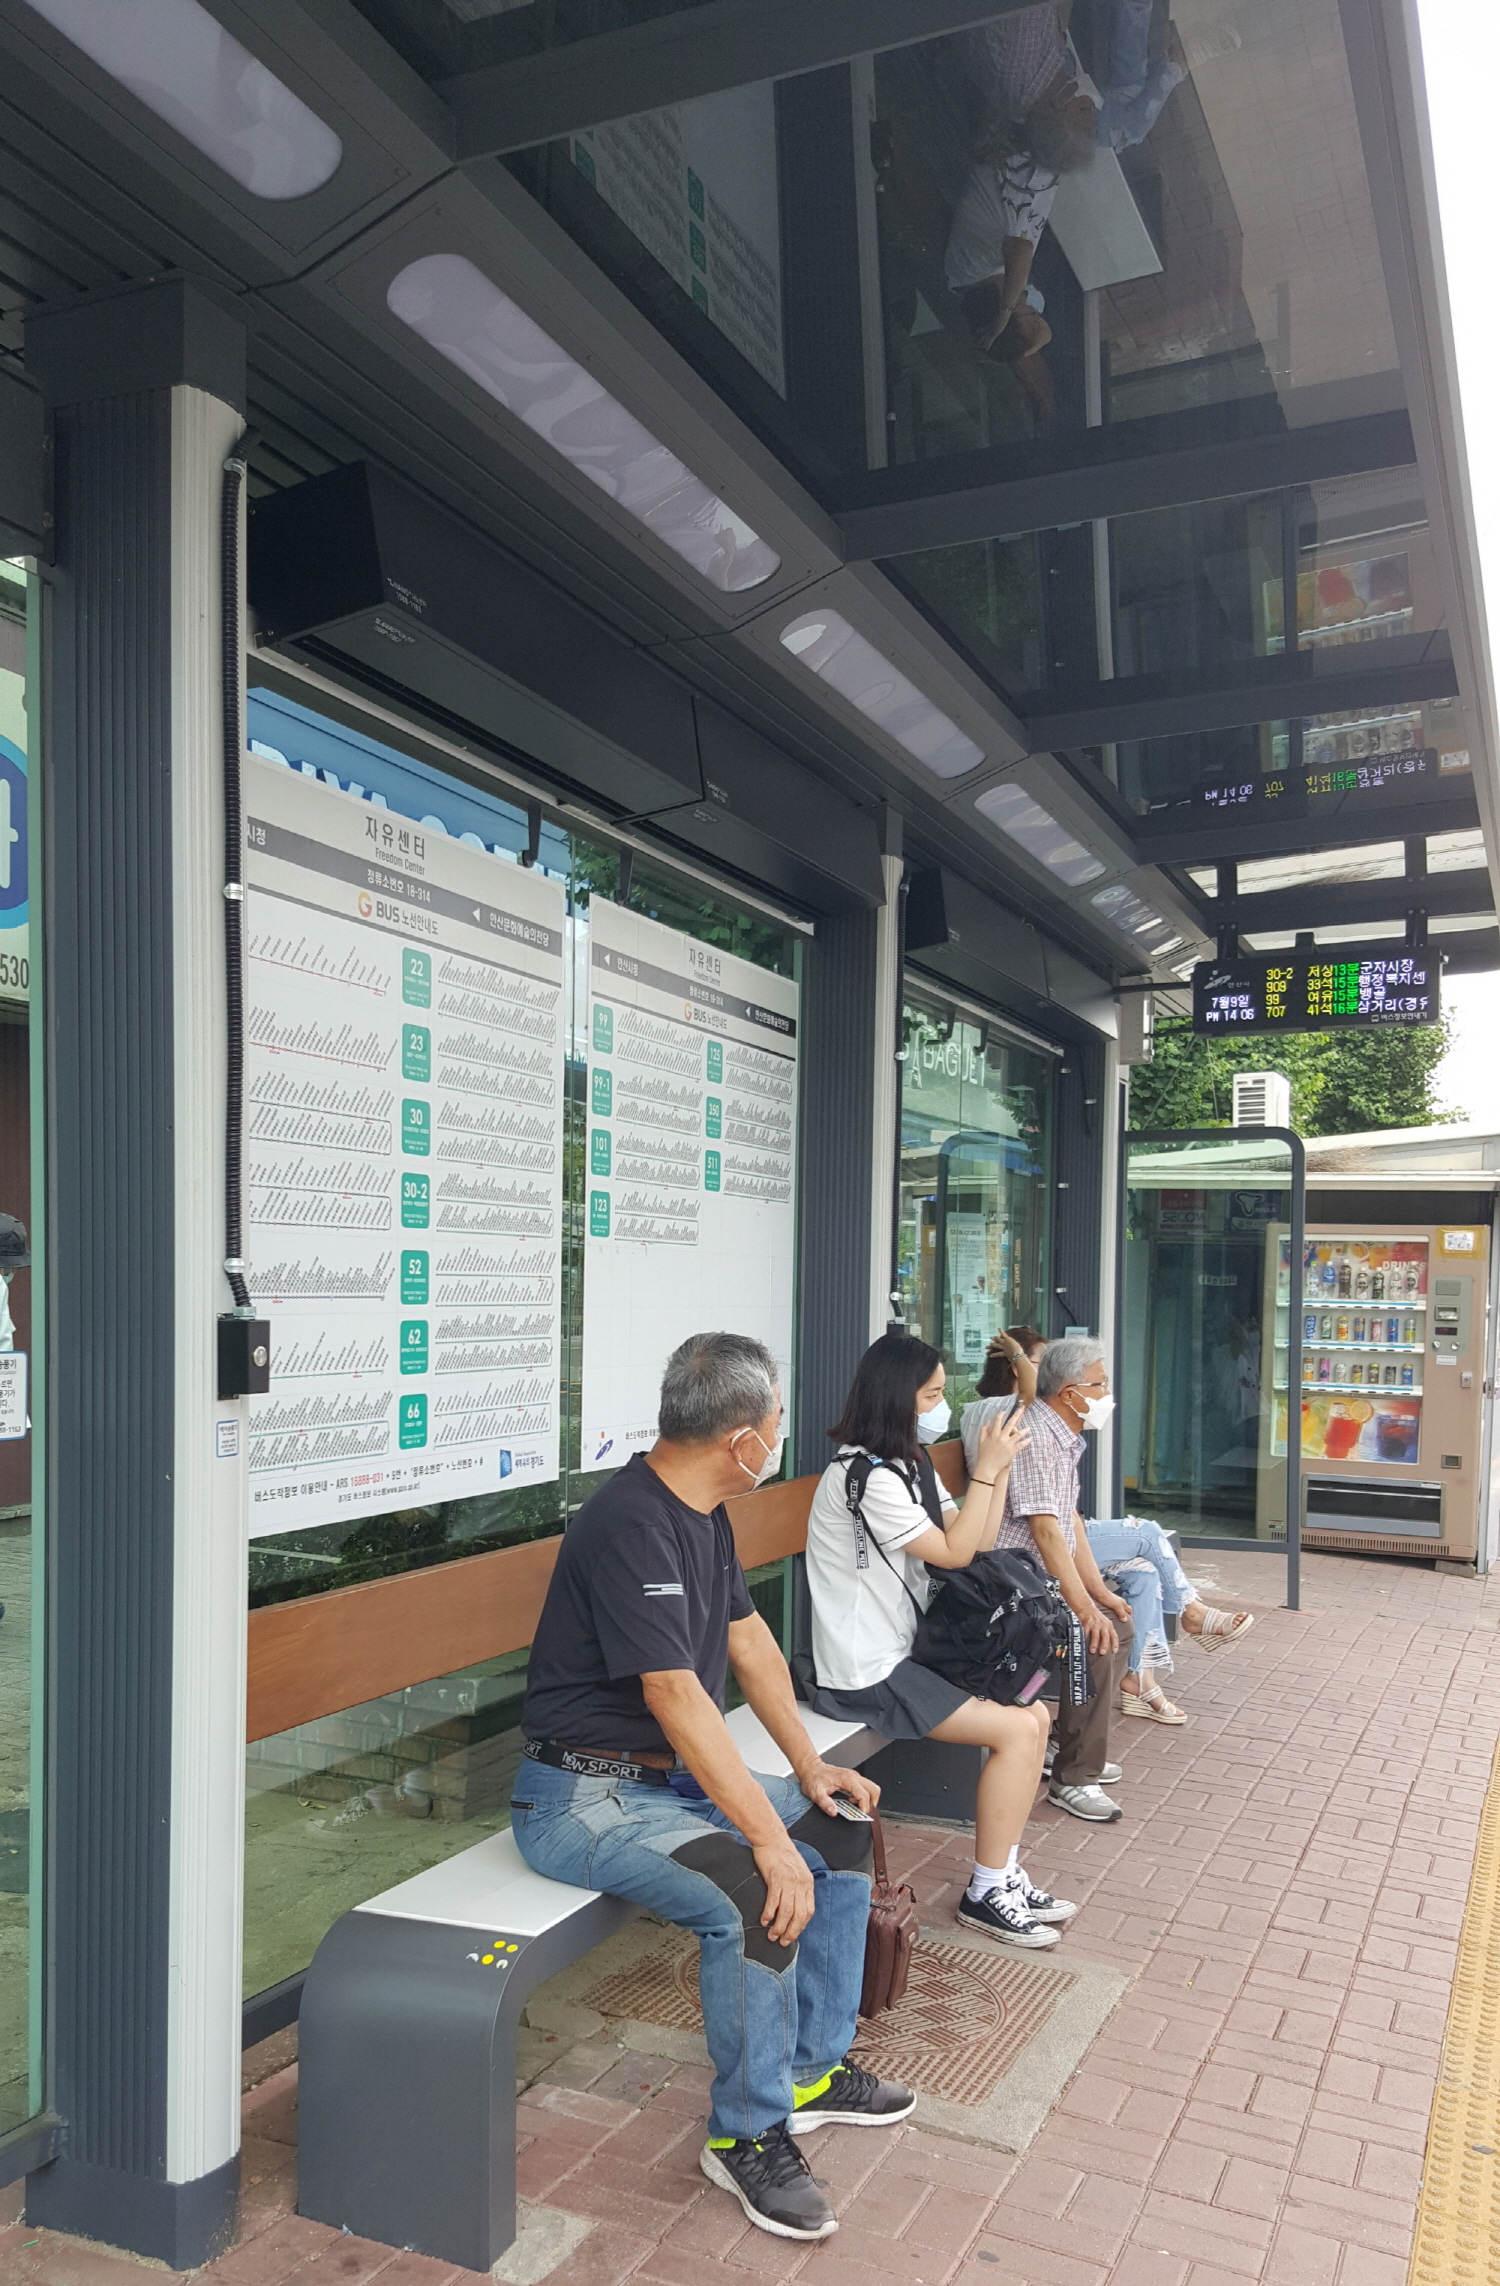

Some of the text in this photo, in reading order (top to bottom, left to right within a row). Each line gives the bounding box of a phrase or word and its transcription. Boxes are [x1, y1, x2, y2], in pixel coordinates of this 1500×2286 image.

[365, 815, 426, 860] 자유센터
[375, 848, 426, 876] Freedom Center
[367, 868, 431, 903] 정류소번호 18-314
[376, 901, 400, 922] BUS
[402, 904, 439, 936] 노선안내도
[490, 912, 550, 947] 안산문화예술의전당
[410, 958, 424, 976] 22
[617, 958, 638, 976] 안산시청
[689, 948, 721, 976] 자유센터
[1360, 959, 1414, 974] 군자시장
[1266, 968, 1294, 980] 30-2
[1307, 978, 1333, 990] 33석
[1358, 971, 1425, 987] 행정복지센
[1266, 981, 1287, 994] 909
[1212, 995, 1249, 1009] 7월9일
[1266, 994, 1280, 1006] 99
[1308, 990, 1333, 1003] 여유
[694, 1008, 707, 1023] BUS
[1206, 1009, 1254, 1022] PM 14 06
[1266, 1006, 1286, 1019] 707
[1307, 1003, 1332, 1015] 41석
[599, 1012, 608, 1027] 99
[410, 1034, 424, 1051] 23
[710, 1047, 720, 1060] 125
[594, 1075, 610, 1091] 99-1
[410, 1109, 423, 1125] 30
[709, 1104, 719, 1116] 350
[595, 1136, 608, 1151] 101
[707, 1157, 718, 1169] 511
[404, 1182, 427, 1199] 30-2
[594, 1199, 607, 1213] 123
[408, 1259, 422, 1275] 52
[408, 1329, 421, 1345] 62
[407, 1404, 420, 1419] 66
[531, 1455, 544, 1469] 경기도
[254, 1486, 298, 1502] 버스도착정보
[301, 1480, 328, 1495] 이용안내
[336, 1478, 348, 1489] ARS
[1073, 1627, 1081, 1656] PEEPSLINE
[525, 1741, 542, 1756] ORT
[588, 1761, 642, 1778] SPORT
